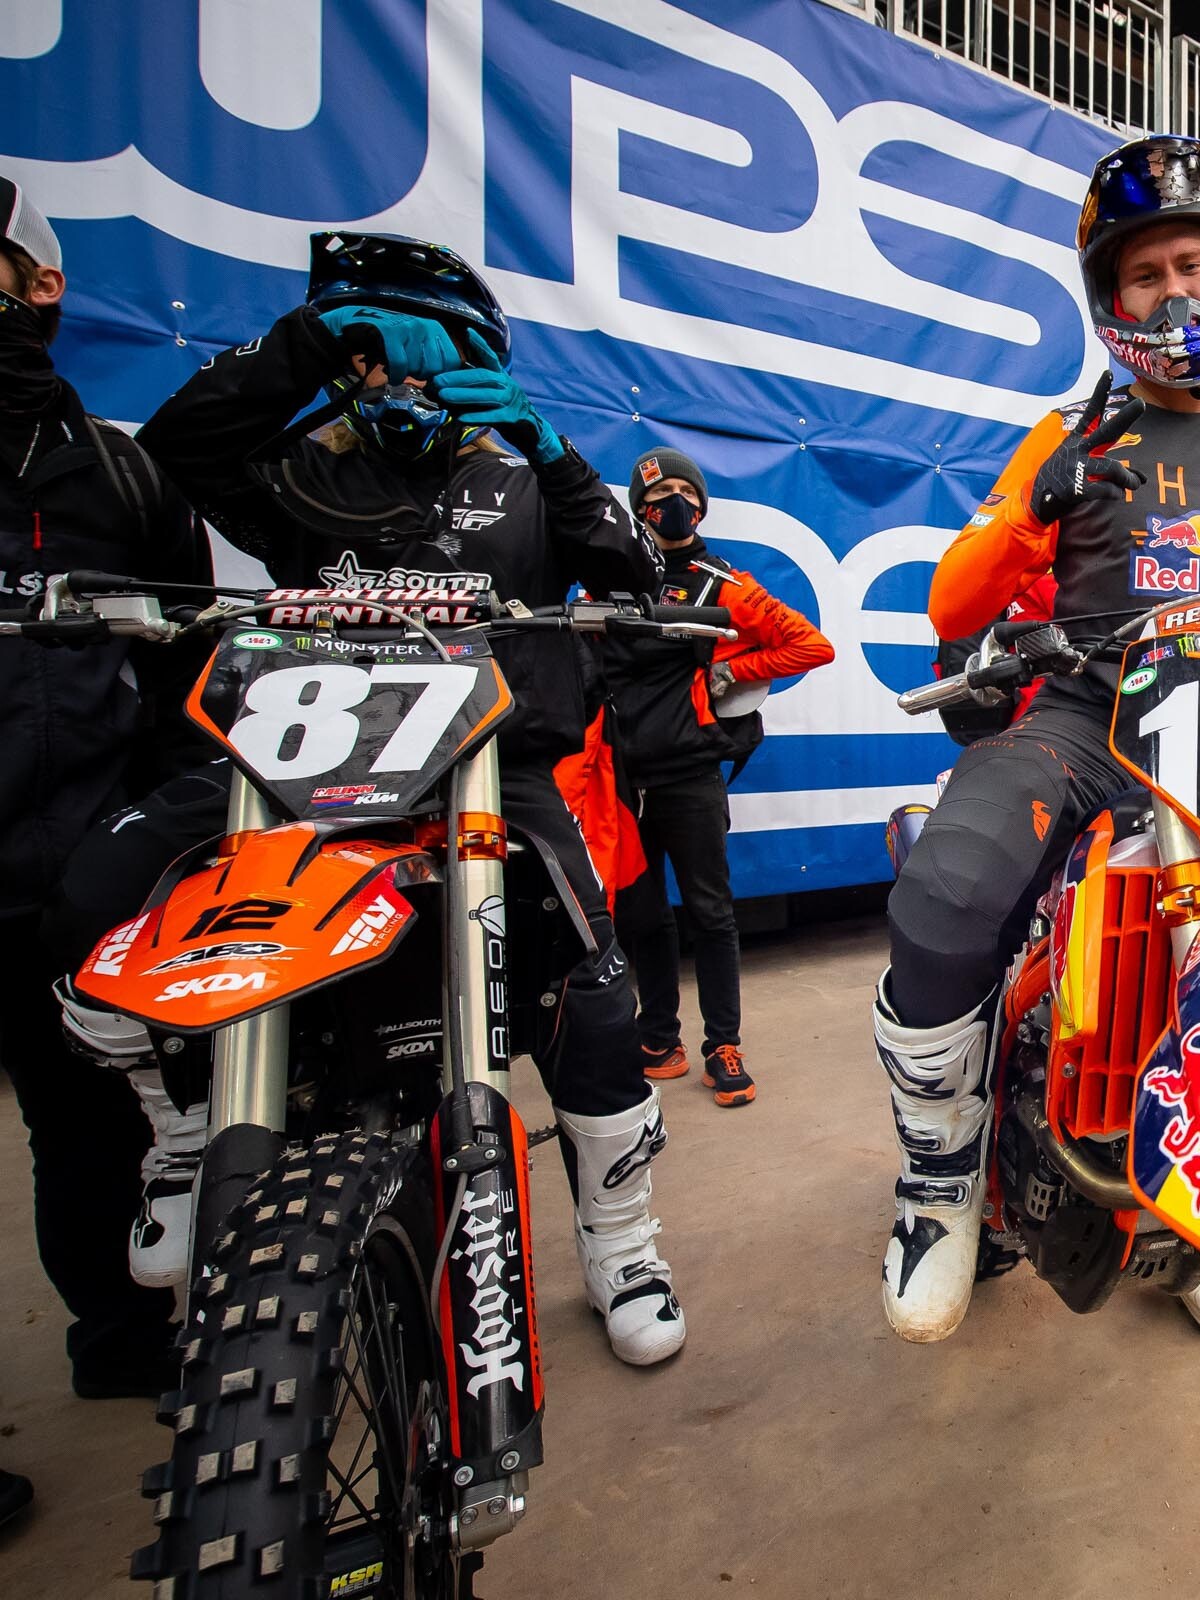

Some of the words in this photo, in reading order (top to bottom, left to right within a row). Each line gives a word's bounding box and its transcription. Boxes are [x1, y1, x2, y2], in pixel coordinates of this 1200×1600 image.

[1074, 461, 1086, 495] THOR
[314, 637, 422, 656] MONSTER
[228, 664, 479, 780] 87
[354, 793, 399, 805] KTM
[180, 897, 295, 942] 12
[371, 913, 404, 948] RACING
[153, 971, 267, 1002] SKDA
[386, 1040, 435, 1059] SKDA
[500, 1188, 523, 1325] TIRE
[331, 1561, 384, 1590] KSR
